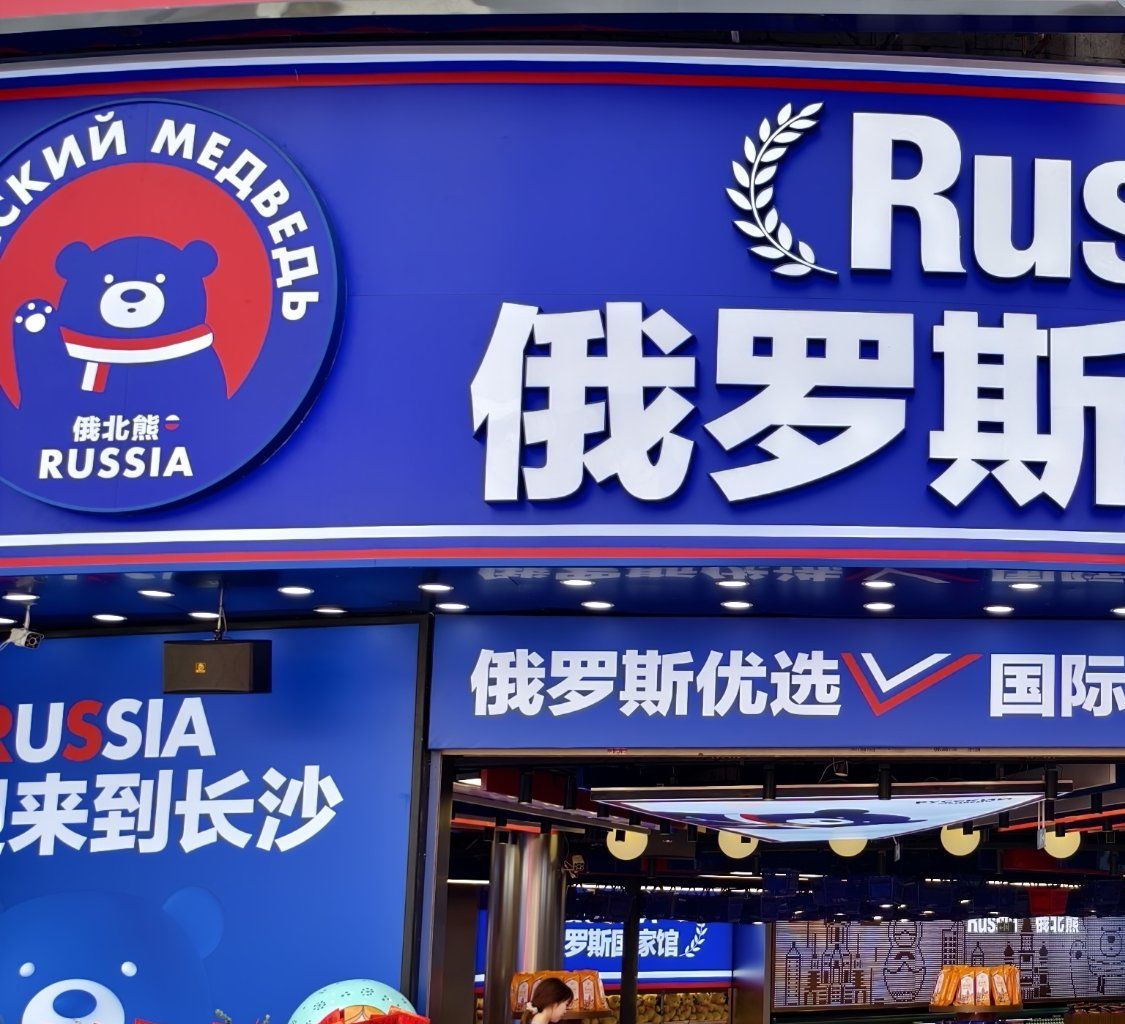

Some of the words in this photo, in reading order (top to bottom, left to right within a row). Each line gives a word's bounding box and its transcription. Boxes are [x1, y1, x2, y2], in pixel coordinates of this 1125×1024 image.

[151, 119, 319, 321] МЕДВЕДЬ
[73, 414, 160, 442] 俄北熊
[38, 446, 193, 480] RUSSIA
[470, 648, 842, 717] 俄罗斯优选
[0, 697, 215, 763] USSIA
[0, 765, 344, 856] 来到长沙
